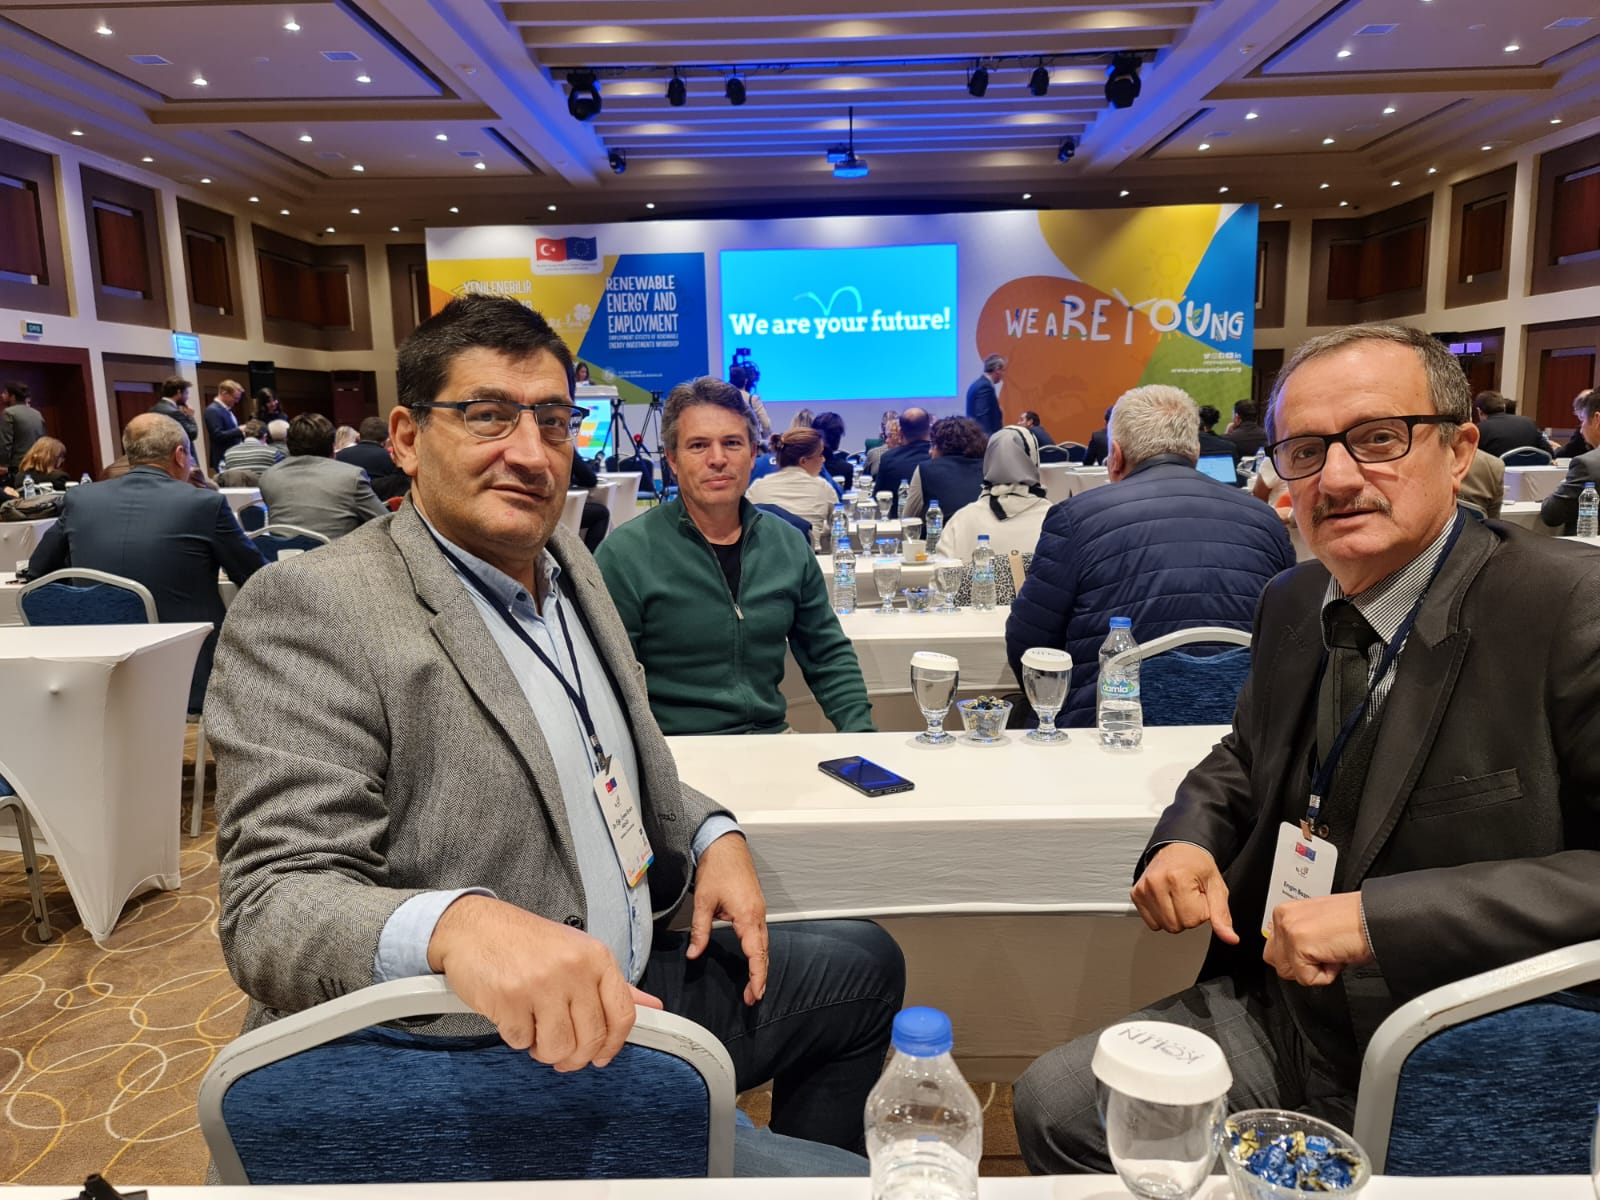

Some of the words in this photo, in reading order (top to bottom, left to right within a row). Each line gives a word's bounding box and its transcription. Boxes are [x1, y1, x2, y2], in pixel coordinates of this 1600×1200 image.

[606, 275, 675, 291] RENEWABLE
[607, 293, 649, 313] ENERGY
[654, 291, 677, 312] AND
[608, 314, 679, 333] EMPLOYMENT
[728, 312, 768, 336] We
[772, 317, 811, 335] are
[814, 314, 867, 339] your
[871, 306, 951, 332] future!
[1005, 308, 1039, 338] WE
